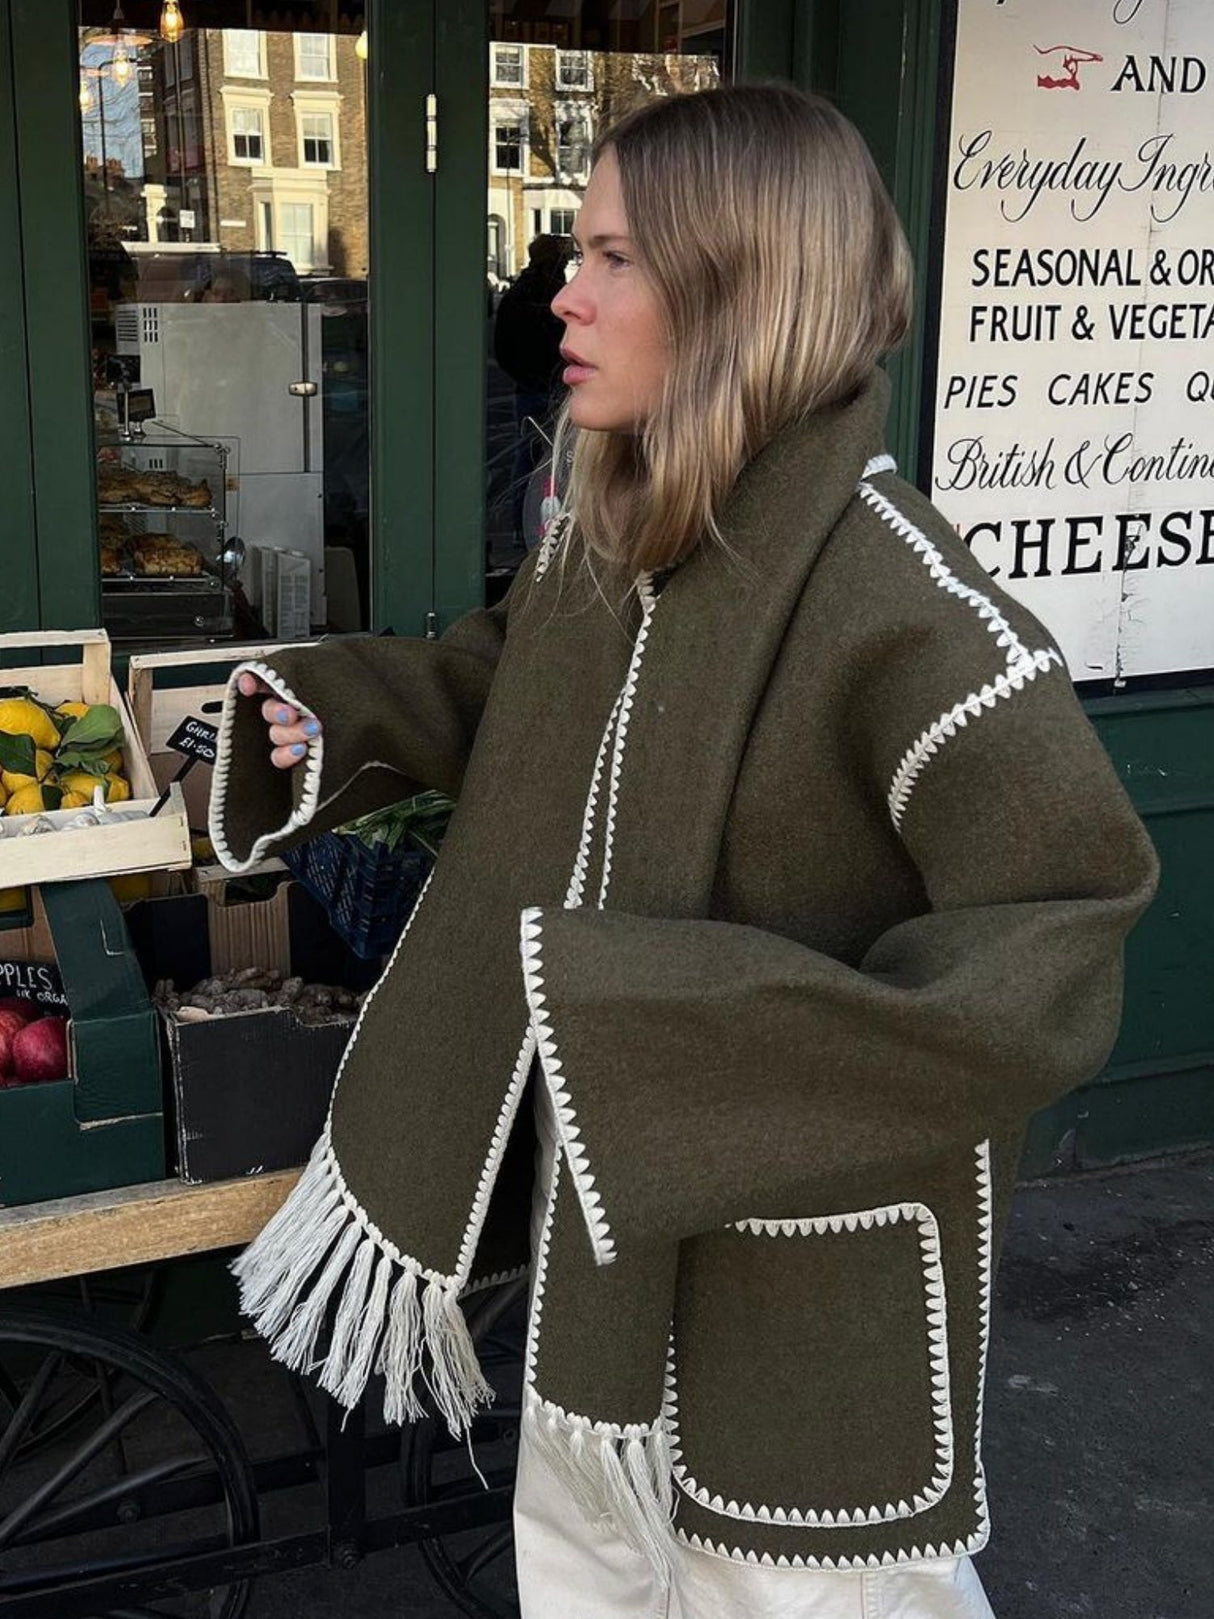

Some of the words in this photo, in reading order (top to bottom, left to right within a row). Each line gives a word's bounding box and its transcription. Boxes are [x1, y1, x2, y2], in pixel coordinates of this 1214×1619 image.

[1110, 55, 1206, 93] AND
[954, 130, 1122, 223] Everyday
[1118, 133, 1214, 223] Ingr
[971, 249, 1141, 287] SEASONAL
[1150, 249, 1171, 286] &
[970, 305, 1061, 342] FRUIT
[1071, 304, 1095, 340] &
[944, 375, 1018, 409] PIES
[1048, 372, 1154, 405] CAKES
[935, 436, 1057, 490] British
[1064, 440, 1103, 489] &
